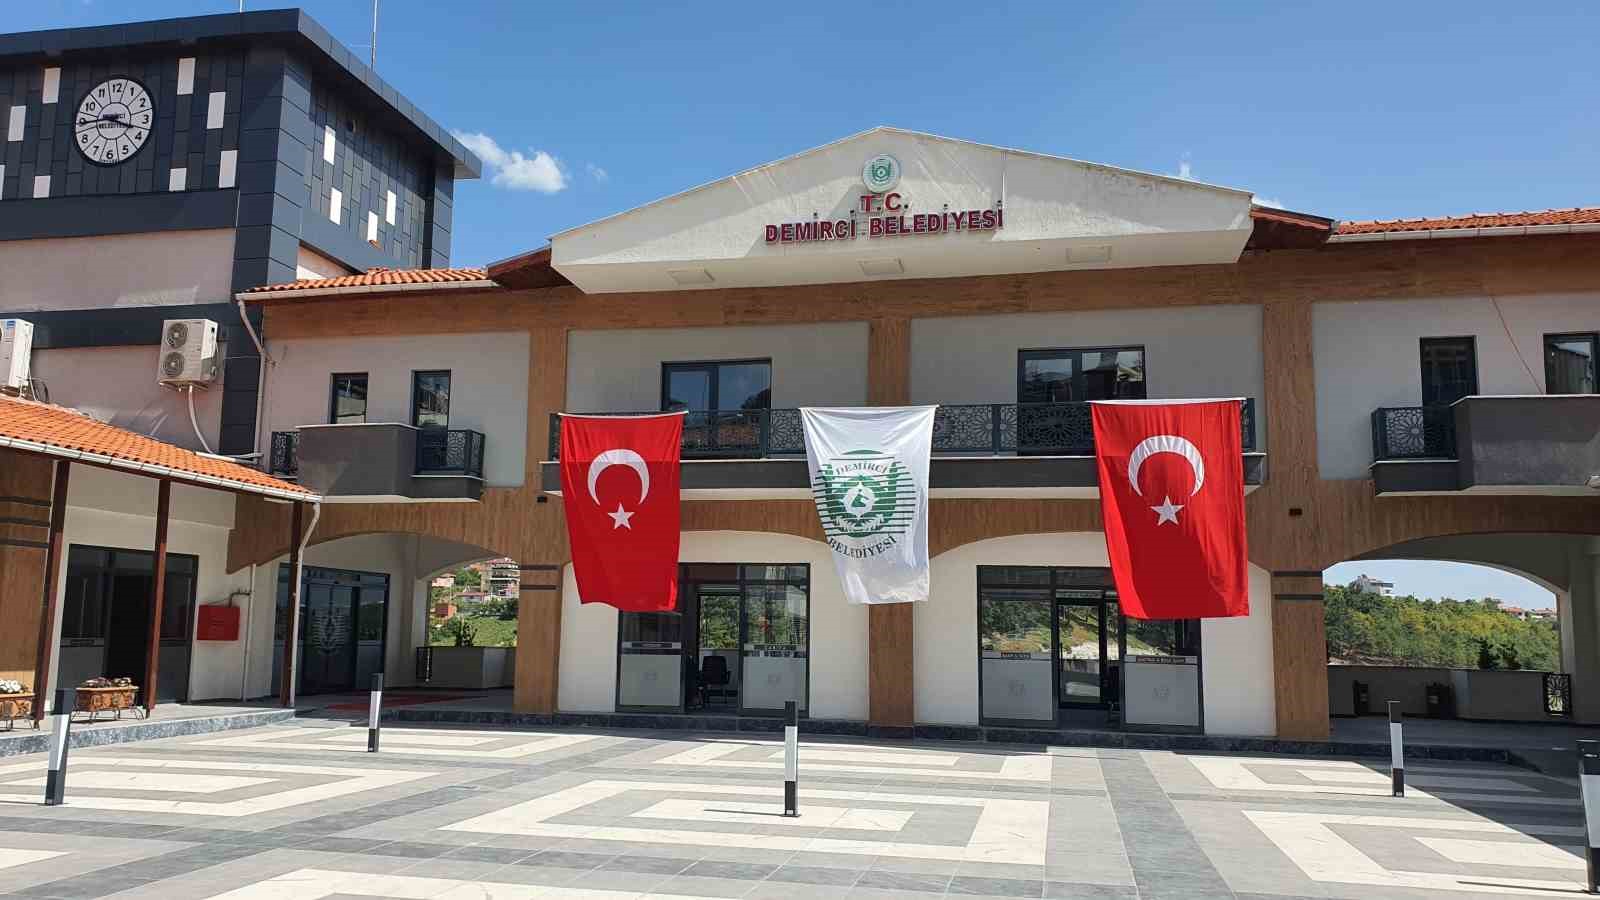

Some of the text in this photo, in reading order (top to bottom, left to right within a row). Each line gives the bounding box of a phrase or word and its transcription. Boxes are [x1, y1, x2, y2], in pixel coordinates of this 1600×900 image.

[112, 83, 122, 93] 12
[130, 87, 135, 96] 1
[98, 88, 105, 98] 11
[85, 102, 96, 111] 10
[139, 98, 146, 107] 2
[142, 114, 149, 124] 3
[81, 134, 88, 143] 8
[135, 131, 142, 140] 4
[93, 146, 99, 155] 7
[122, 145, 129, 154] 5
[106, 150, 113, 159] 6
[860, 192, 909, 213] T.C.
[765, 200, 1003, 242] DEMİRCİ BELEDİYESİ
